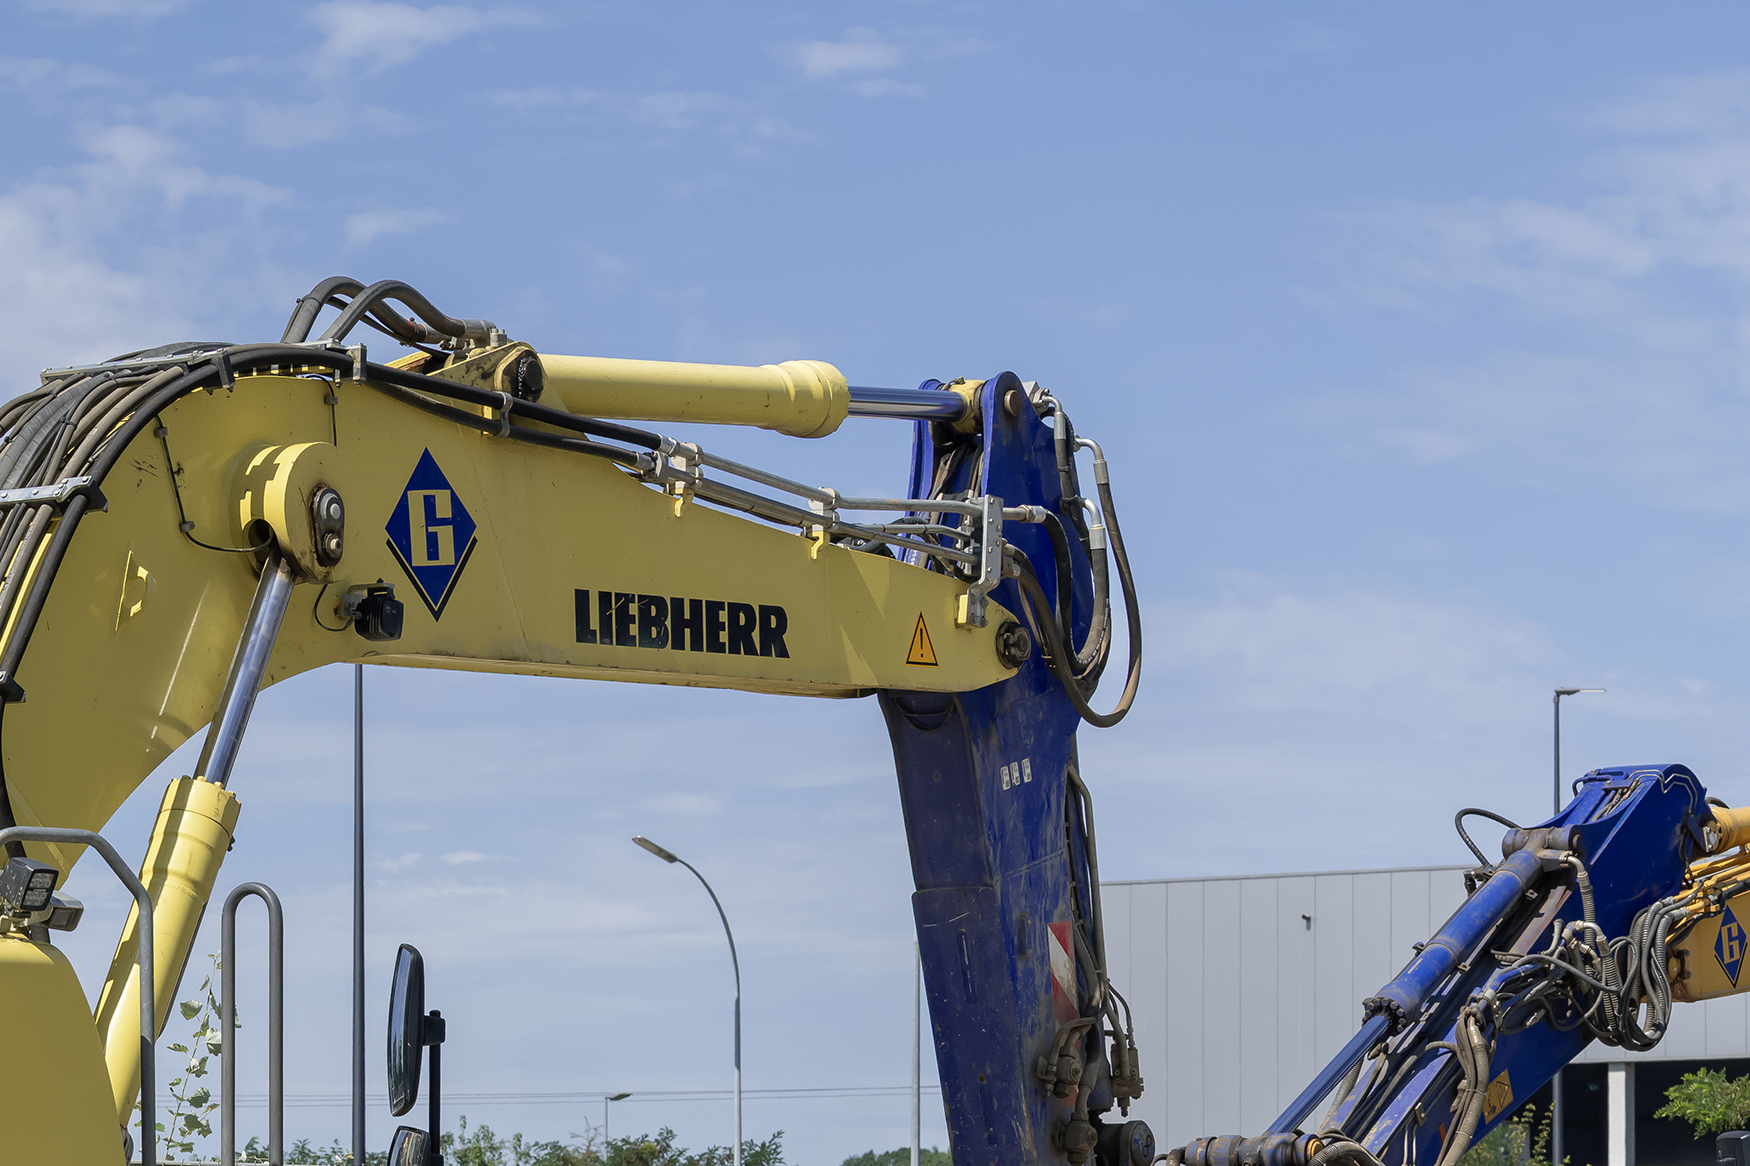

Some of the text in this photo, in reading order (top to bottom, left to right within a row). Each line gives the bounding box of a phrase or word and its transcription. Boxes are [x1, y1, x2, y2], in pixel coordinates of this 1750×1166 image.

[409, 489, 455, 567] G
[575, 588, 790, 659] LIEBHERR
[1721, 921, 1741, 965] G
